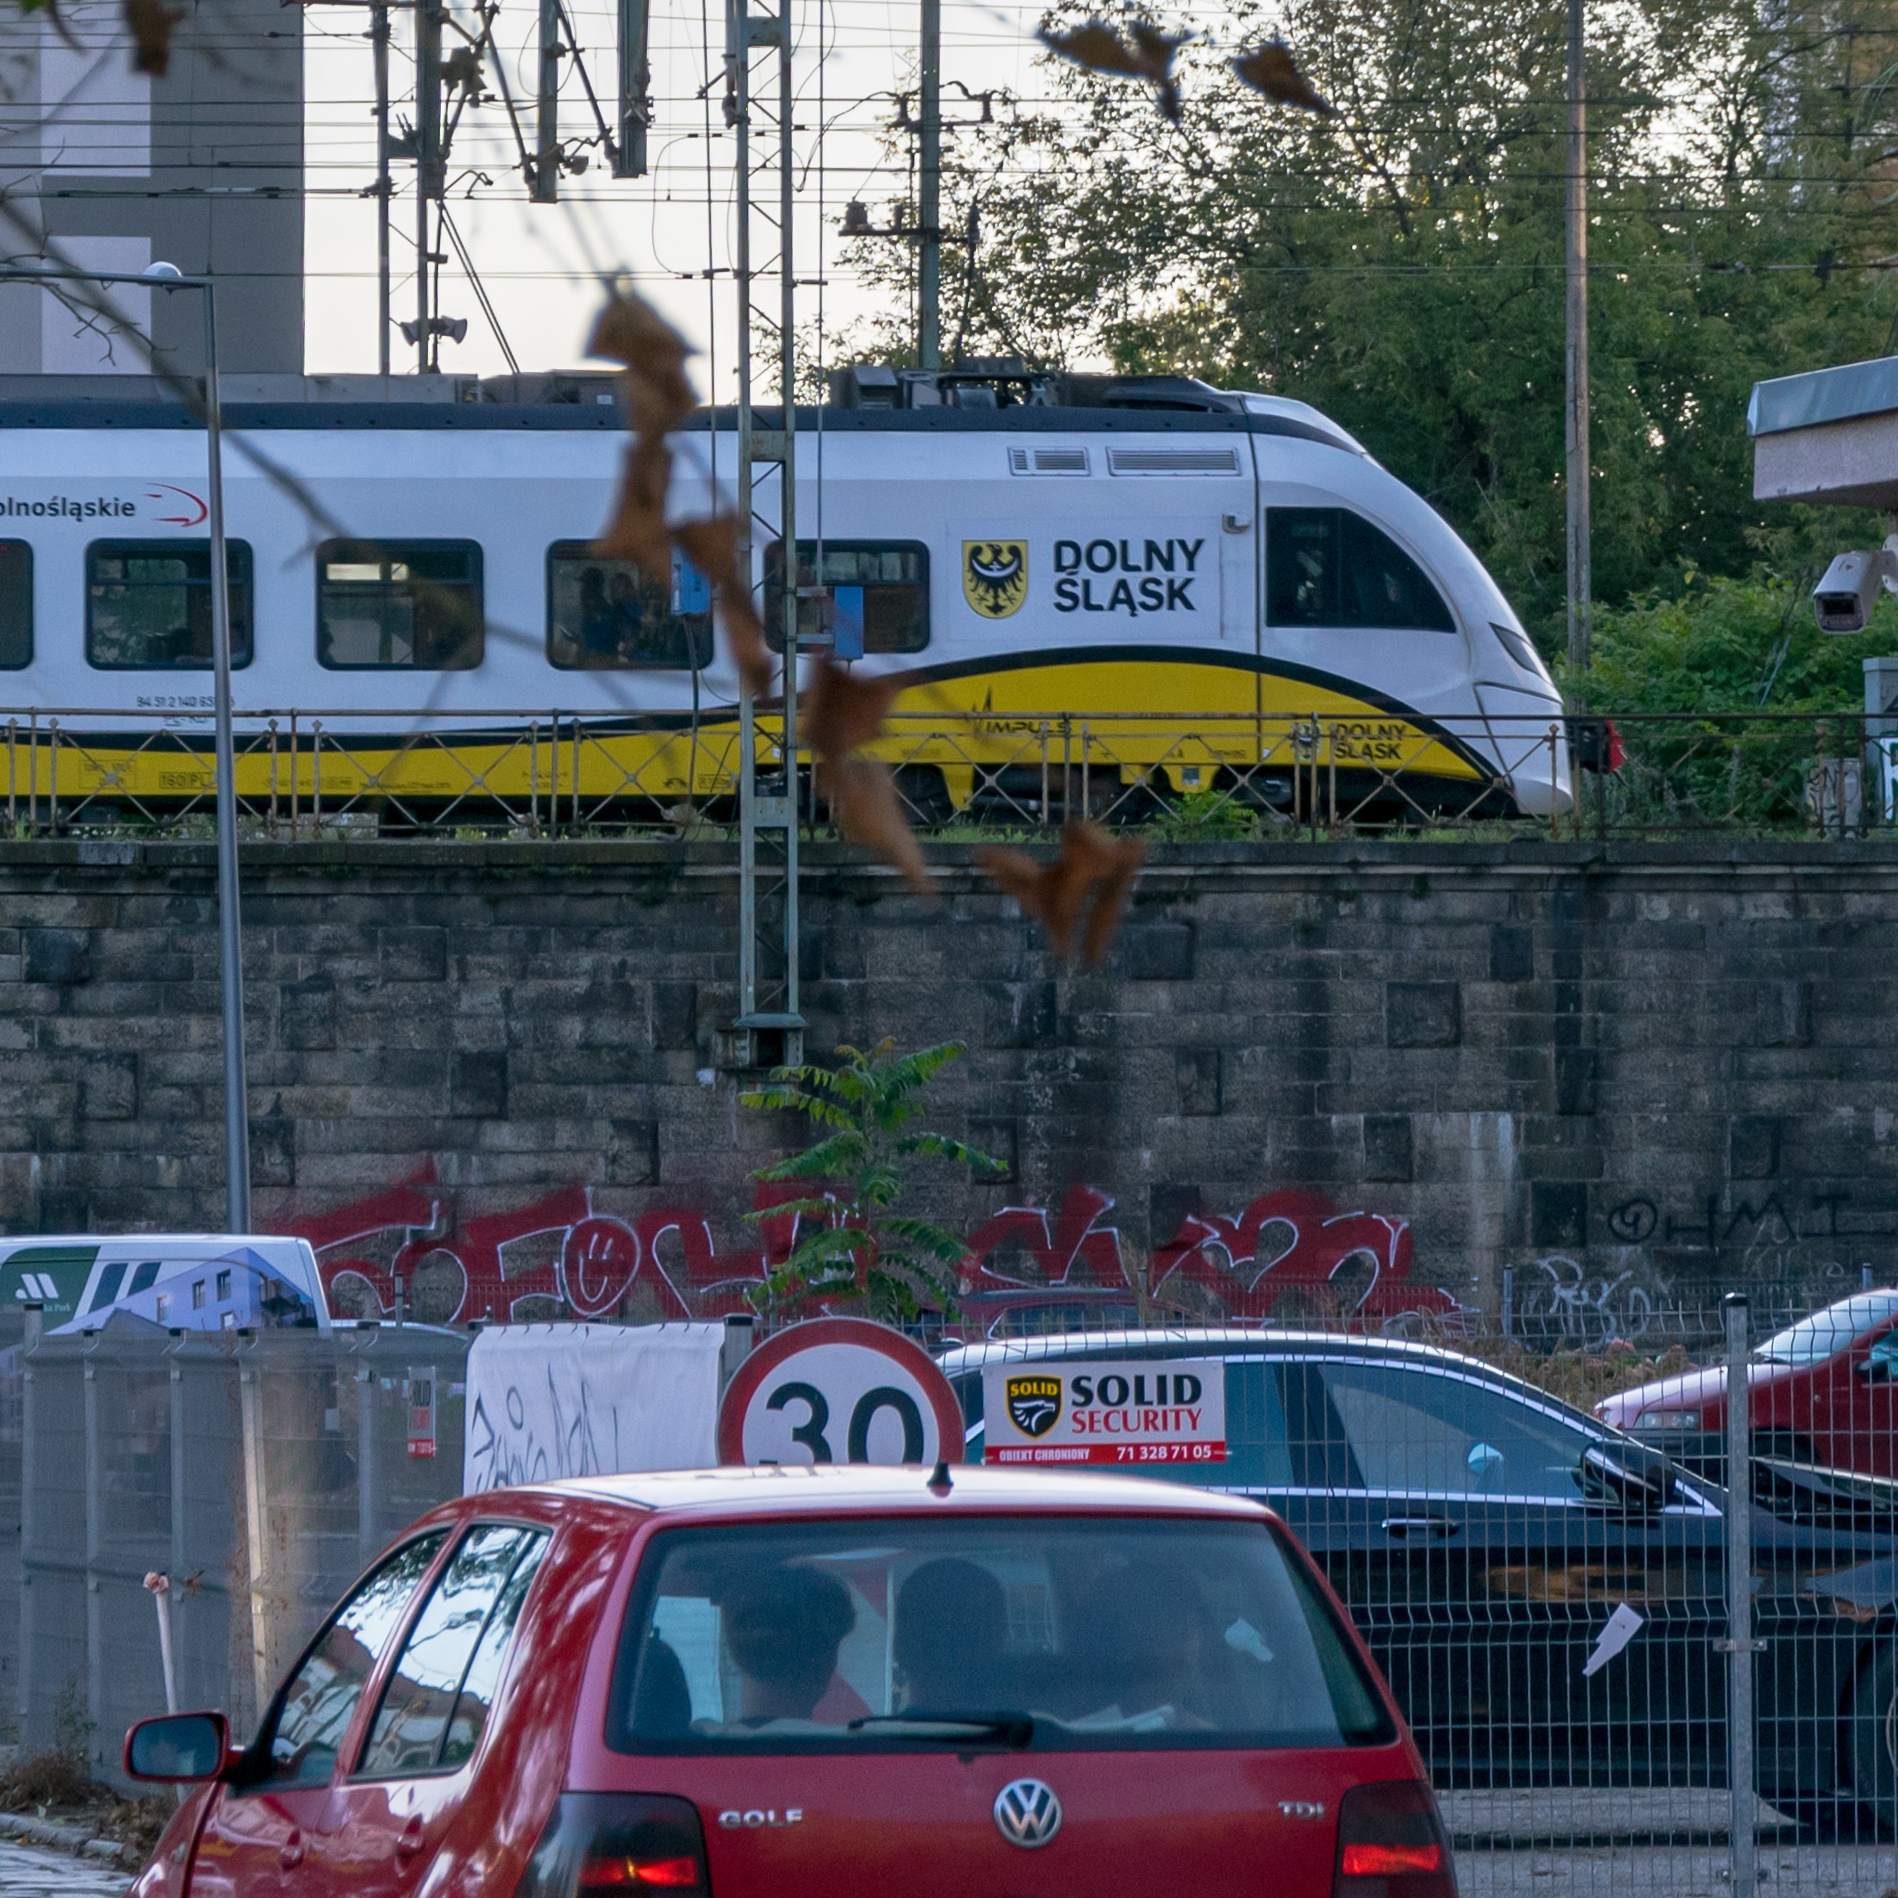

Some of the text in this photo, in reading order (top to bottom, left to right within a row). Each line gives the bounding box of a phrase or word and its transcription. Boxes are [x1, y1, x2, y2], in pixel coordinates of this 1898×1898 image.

[1053, 539, 1205, 573] DOLNY
[1053, 568, 1198, 617] ŚLĄSK
[1010, 1382, 1059, 1397] SOLID
[1071, 1374, 1202, 1407] SOLID
[759, 1381, 925, 1464] 30
[1071, 1407, 1202, 1434] SECURITY
[1117, 1446, 1134, 1461] 71
[1140, 1446, 1167, 1460] 328
[1171, 1446, 1188, 1459] 71
[1192, 1444, 1211, 1459] 05
[718, 1808, 804, 1830] GOLF
[1278, 1801, 1325, 1820] TDI
